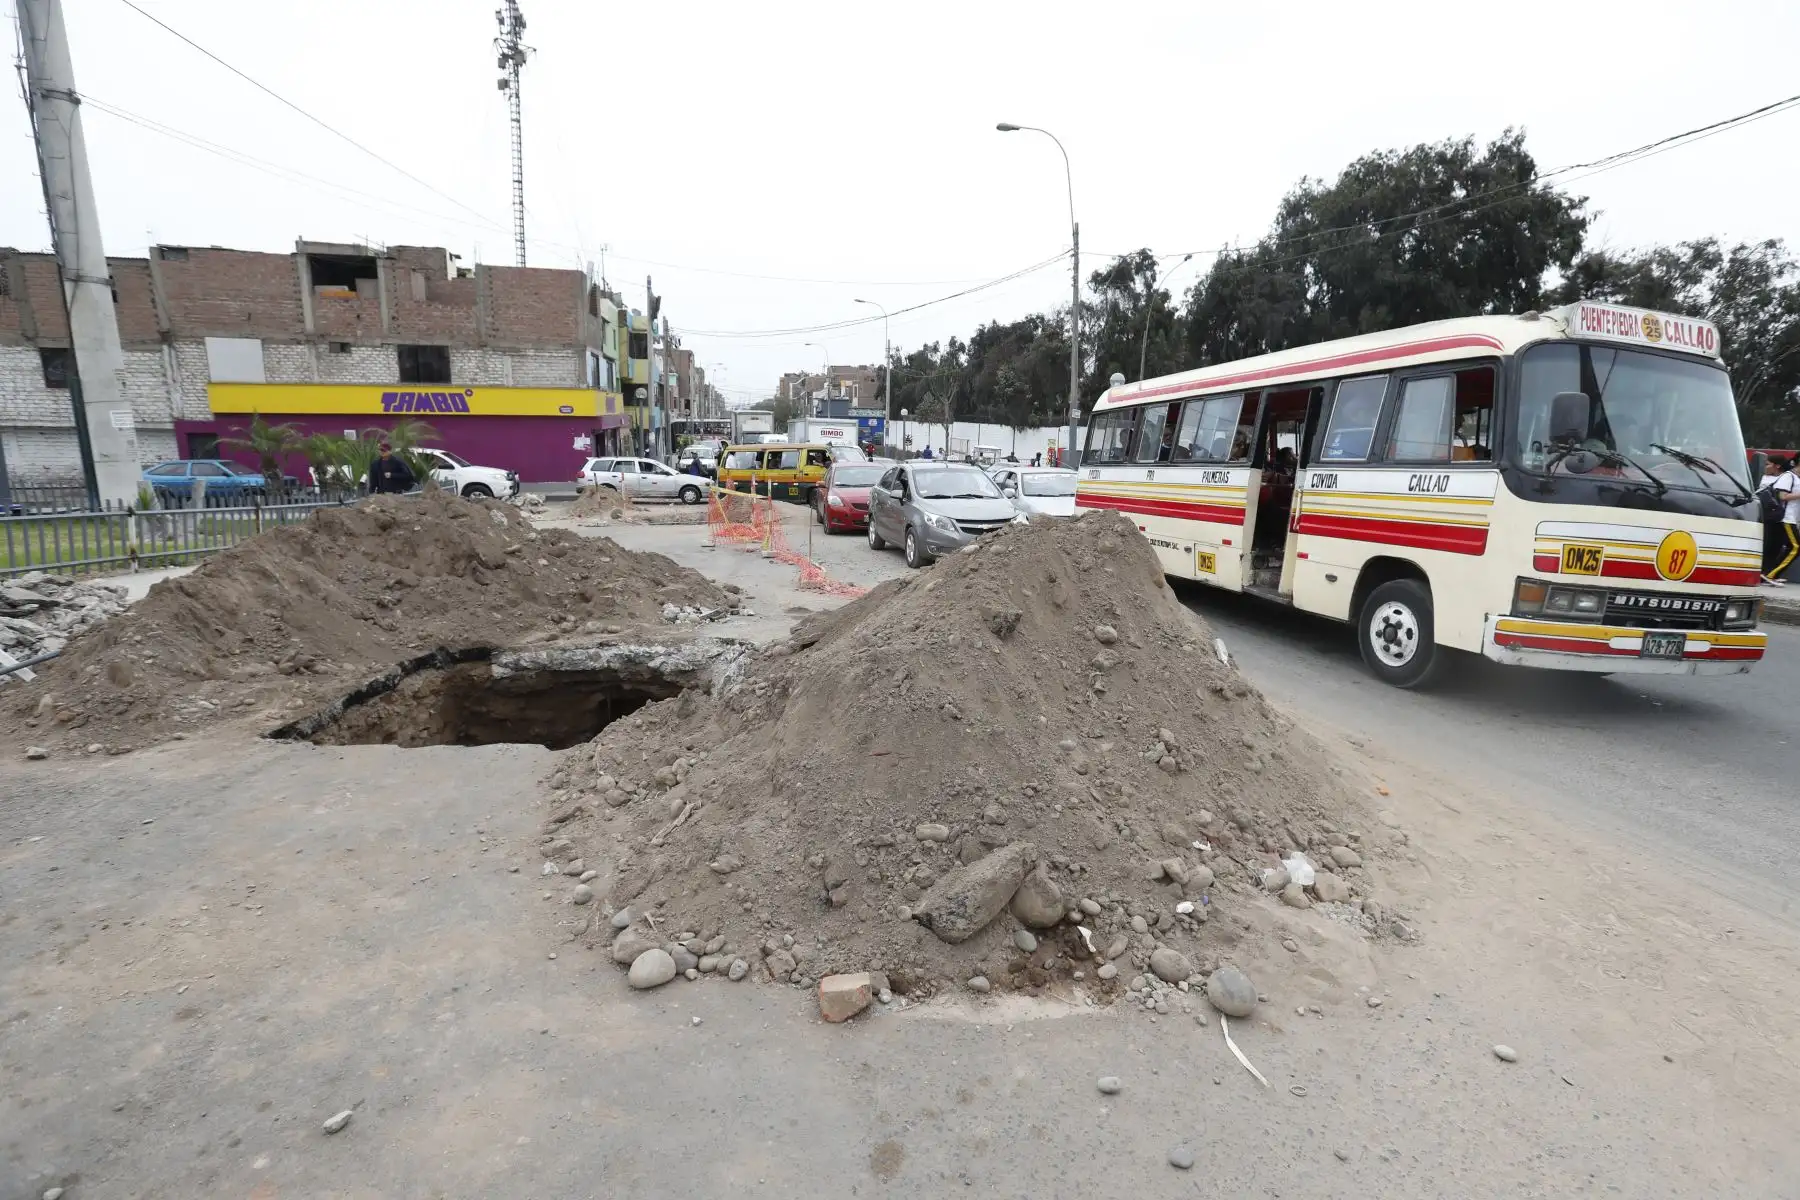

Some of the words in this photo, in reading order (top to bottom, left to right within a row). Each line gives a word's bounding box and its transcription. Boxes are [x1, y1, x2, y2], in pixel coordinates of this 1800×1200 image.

[1581, 306, 1610, 334] PUENTE
[1612, 311, 1639, 338] PIEDRA
[1643, 317, 1659, 326] OM
[1646, 326, 1661, 338] 25
[1664, 319, 1714, 350] CALLAO
[381, 392, 470, 412] TAMBO
[820, 429, 844, 437] BIMBO
[1201, 470, 1230, 484] PALMERAS
[1311, 473, 1338, 489] COVIDA
[1408, 473, 1450, 493] CALLAO
[1566, 547, 1601, 572] OM25
[1668, 549, 1688, 574] 87
[1614, 595, 1721, 612] MITSUBISHI
